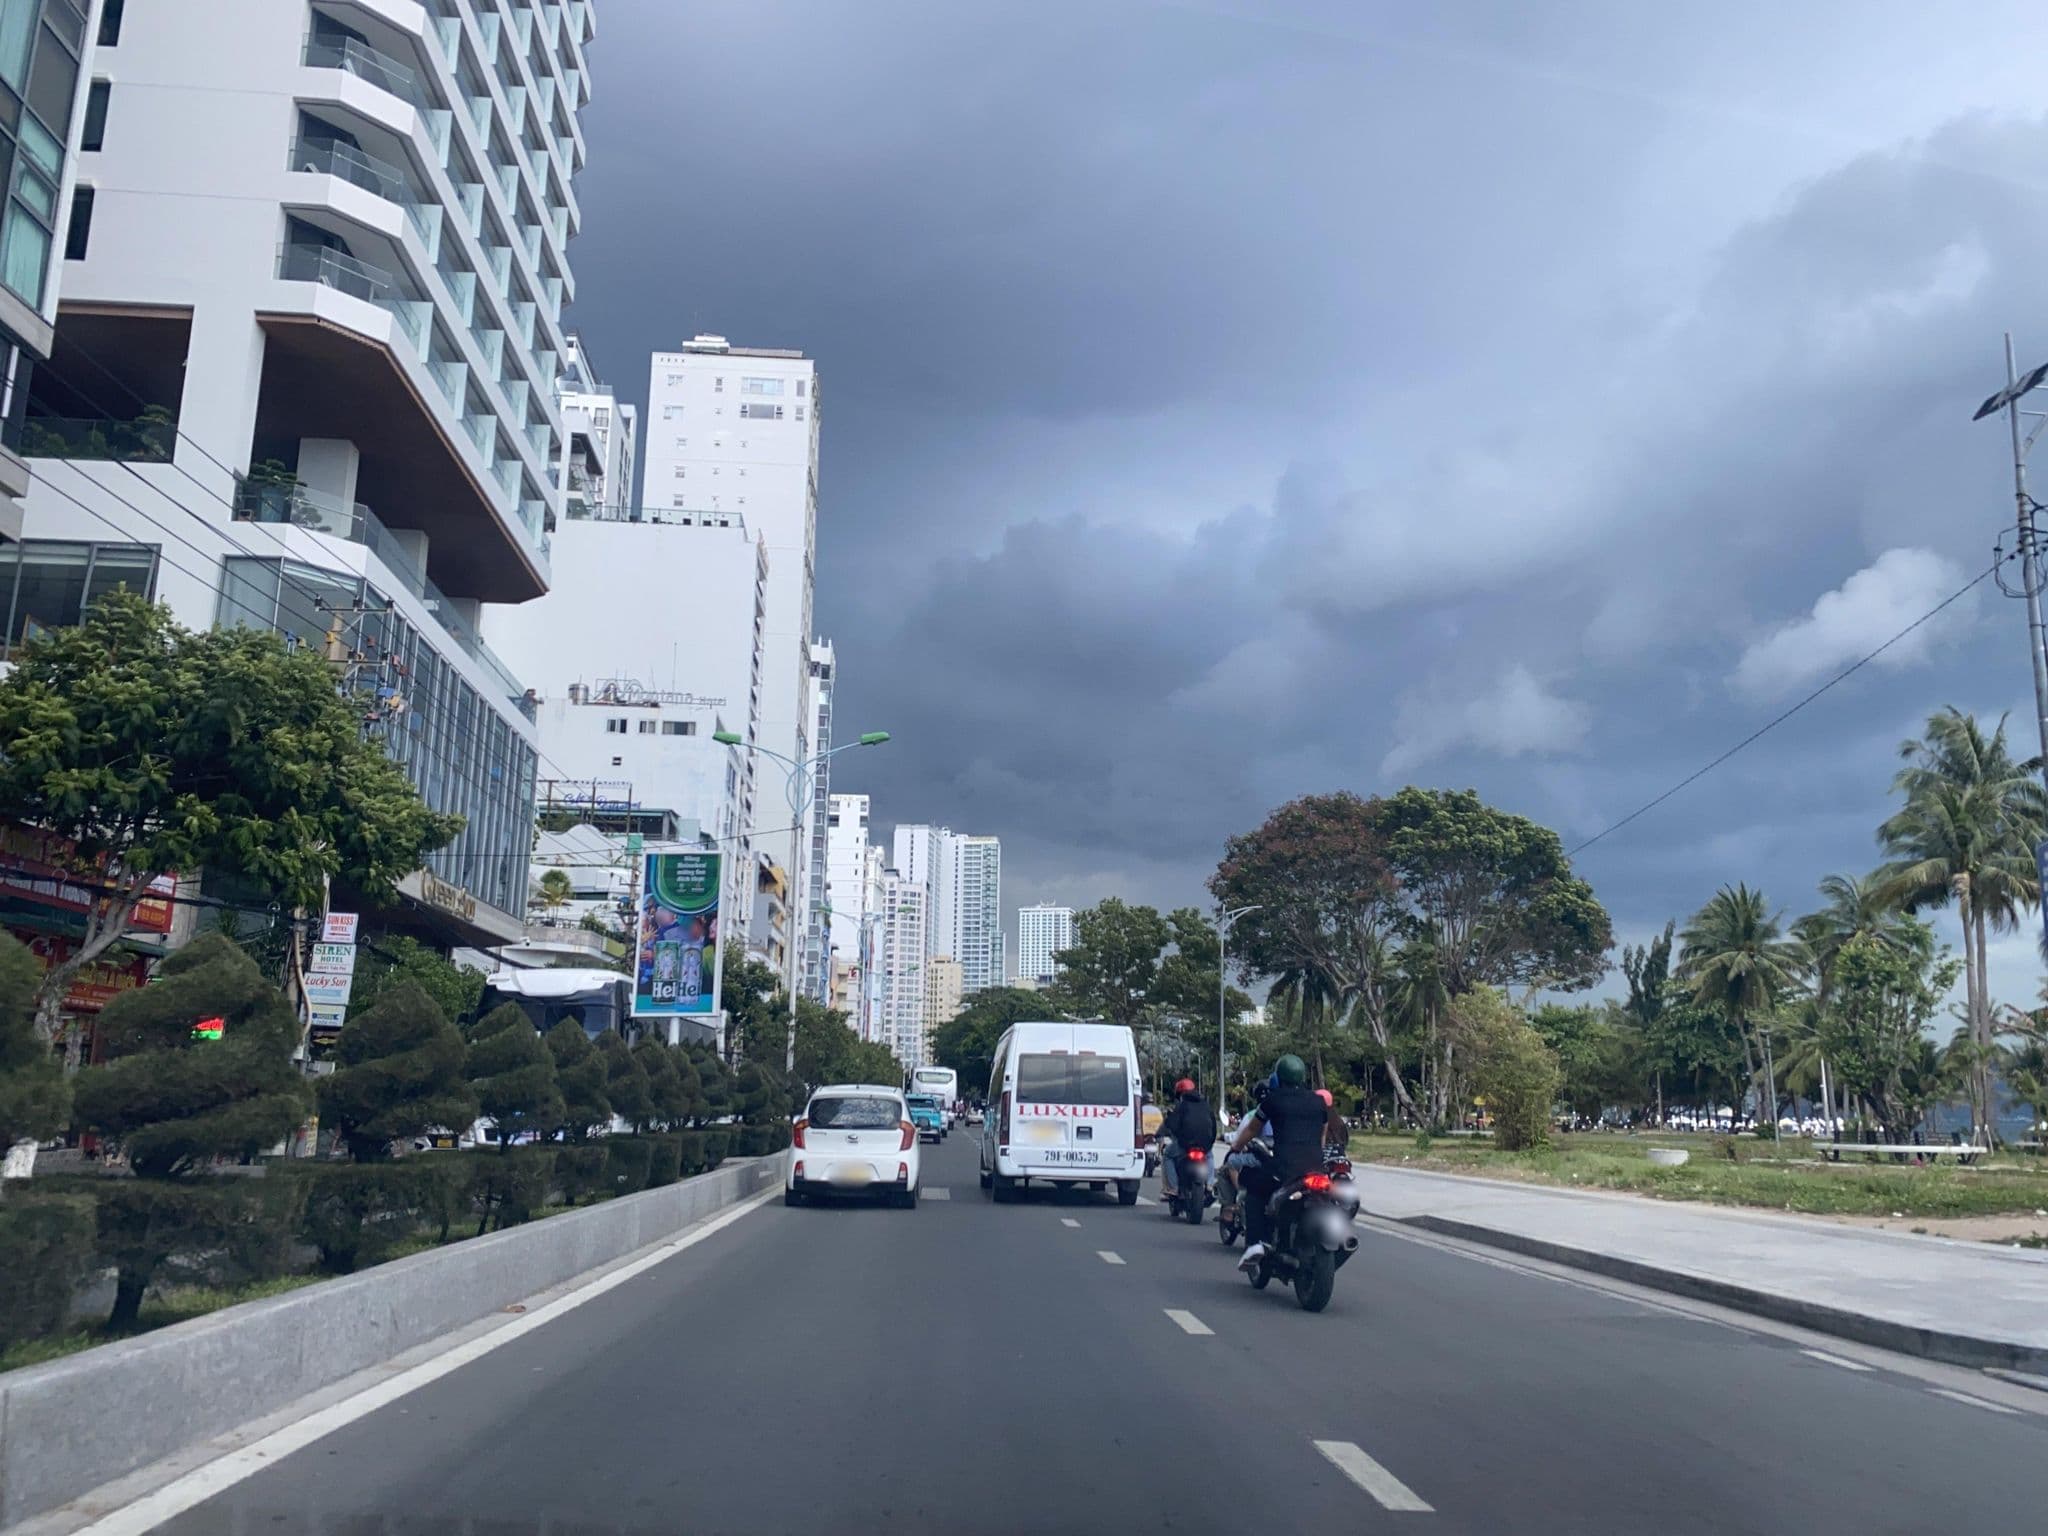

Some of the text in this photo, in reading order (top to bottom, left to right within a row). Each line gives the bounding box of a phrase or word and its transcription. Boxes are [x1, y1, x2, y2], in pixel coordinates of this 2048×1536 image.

[314, 945, 352, 956] SIREN
[305, 976, 348, 988] Lucky Sun
[1019, 1104, 1126, 1118] LUXURY
